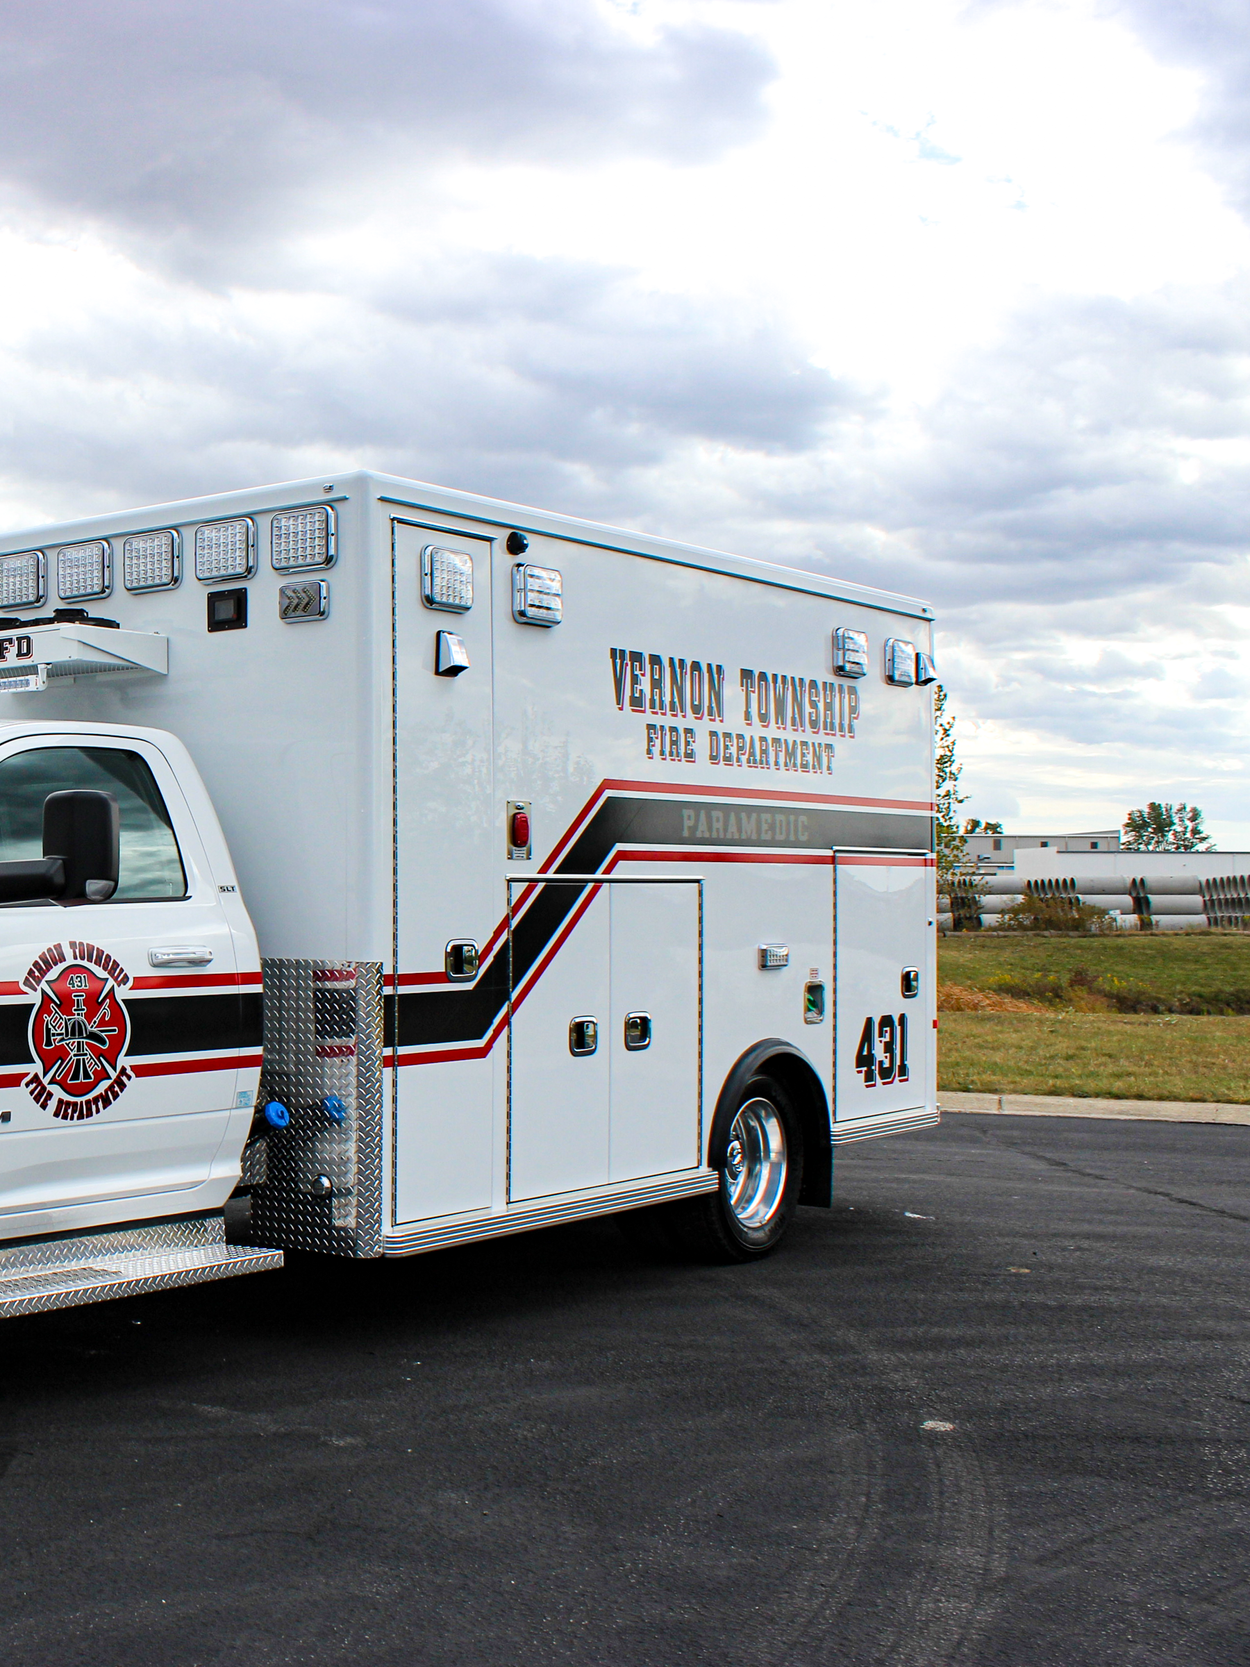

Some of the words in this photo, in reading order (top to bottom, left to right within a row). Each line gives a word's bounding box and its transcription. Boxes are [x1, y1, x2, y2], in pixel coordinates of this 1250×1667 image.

[610, 647, 725, 723] VERNON
[739, 668, 860, 739] TOWNSHIP
[646, 723, 696, 763] FIRE
[708, 730, 835, 775] DEPARTMENT
[682, 809, 809, 841] PARAMEDIC
[218, 885, 237, 893] SLT
[22, 942, 67, 992] VERNON
[68, 940, 130, 988] TOWNSHIP
[67, 974, 88, 989] 431
[855, 1012, 910, 1088] 431
[24, 1072, 54, 1111] FIRE
[52, 1065, 132, 1121] DEPARTMENT
